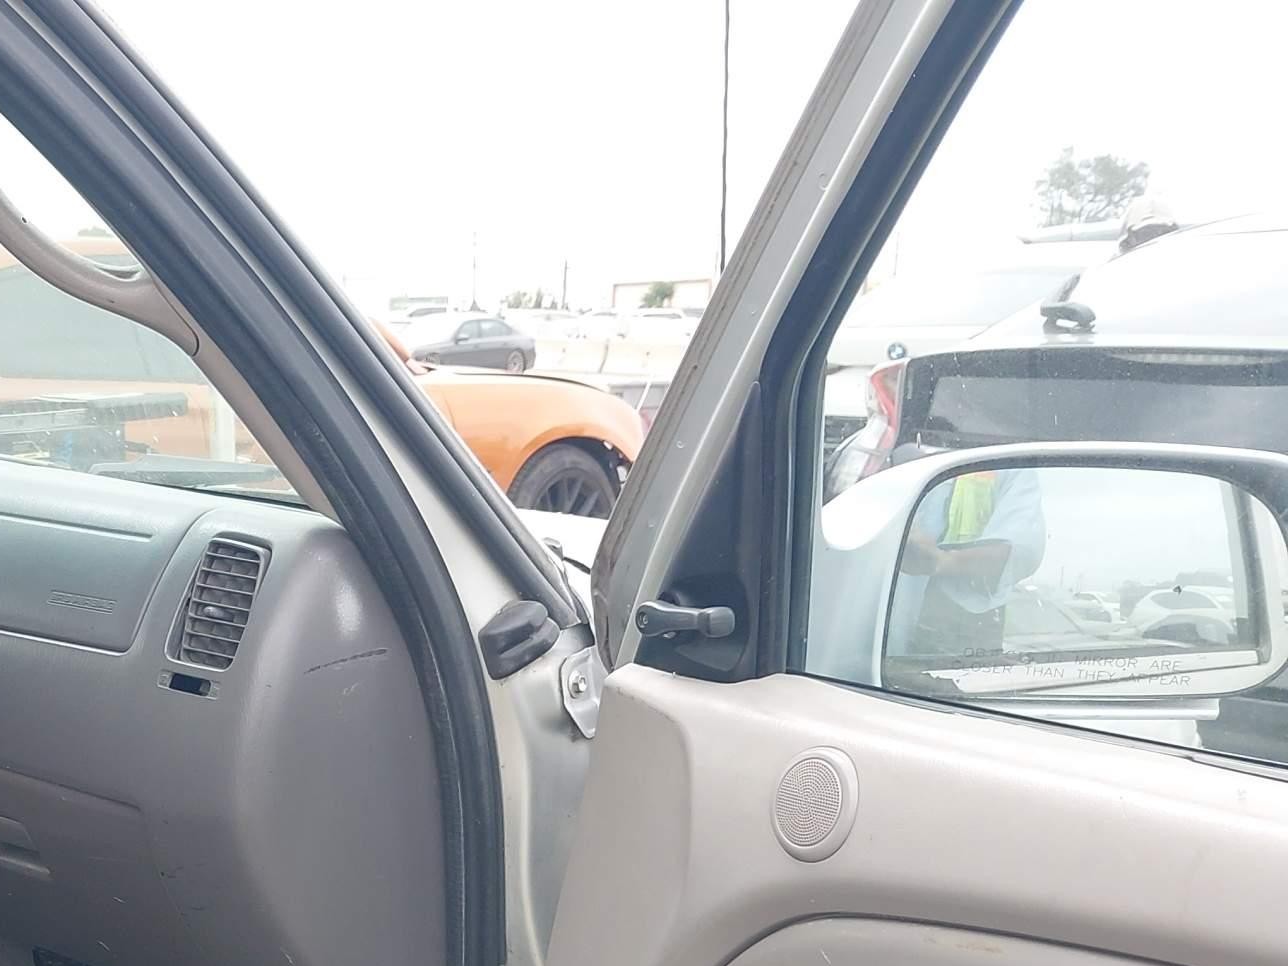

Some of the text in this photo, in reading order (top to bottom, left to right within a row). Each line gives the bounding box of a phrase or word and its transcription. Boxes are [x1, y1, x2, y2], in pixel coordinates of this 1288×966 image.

[1074, 655, 1138, 668] MIRROR
[1149, 660, 1182, 671] ARE
[1024, 665, 1065, 679] THAN
[1077, 669, 1117, 681] THEY
